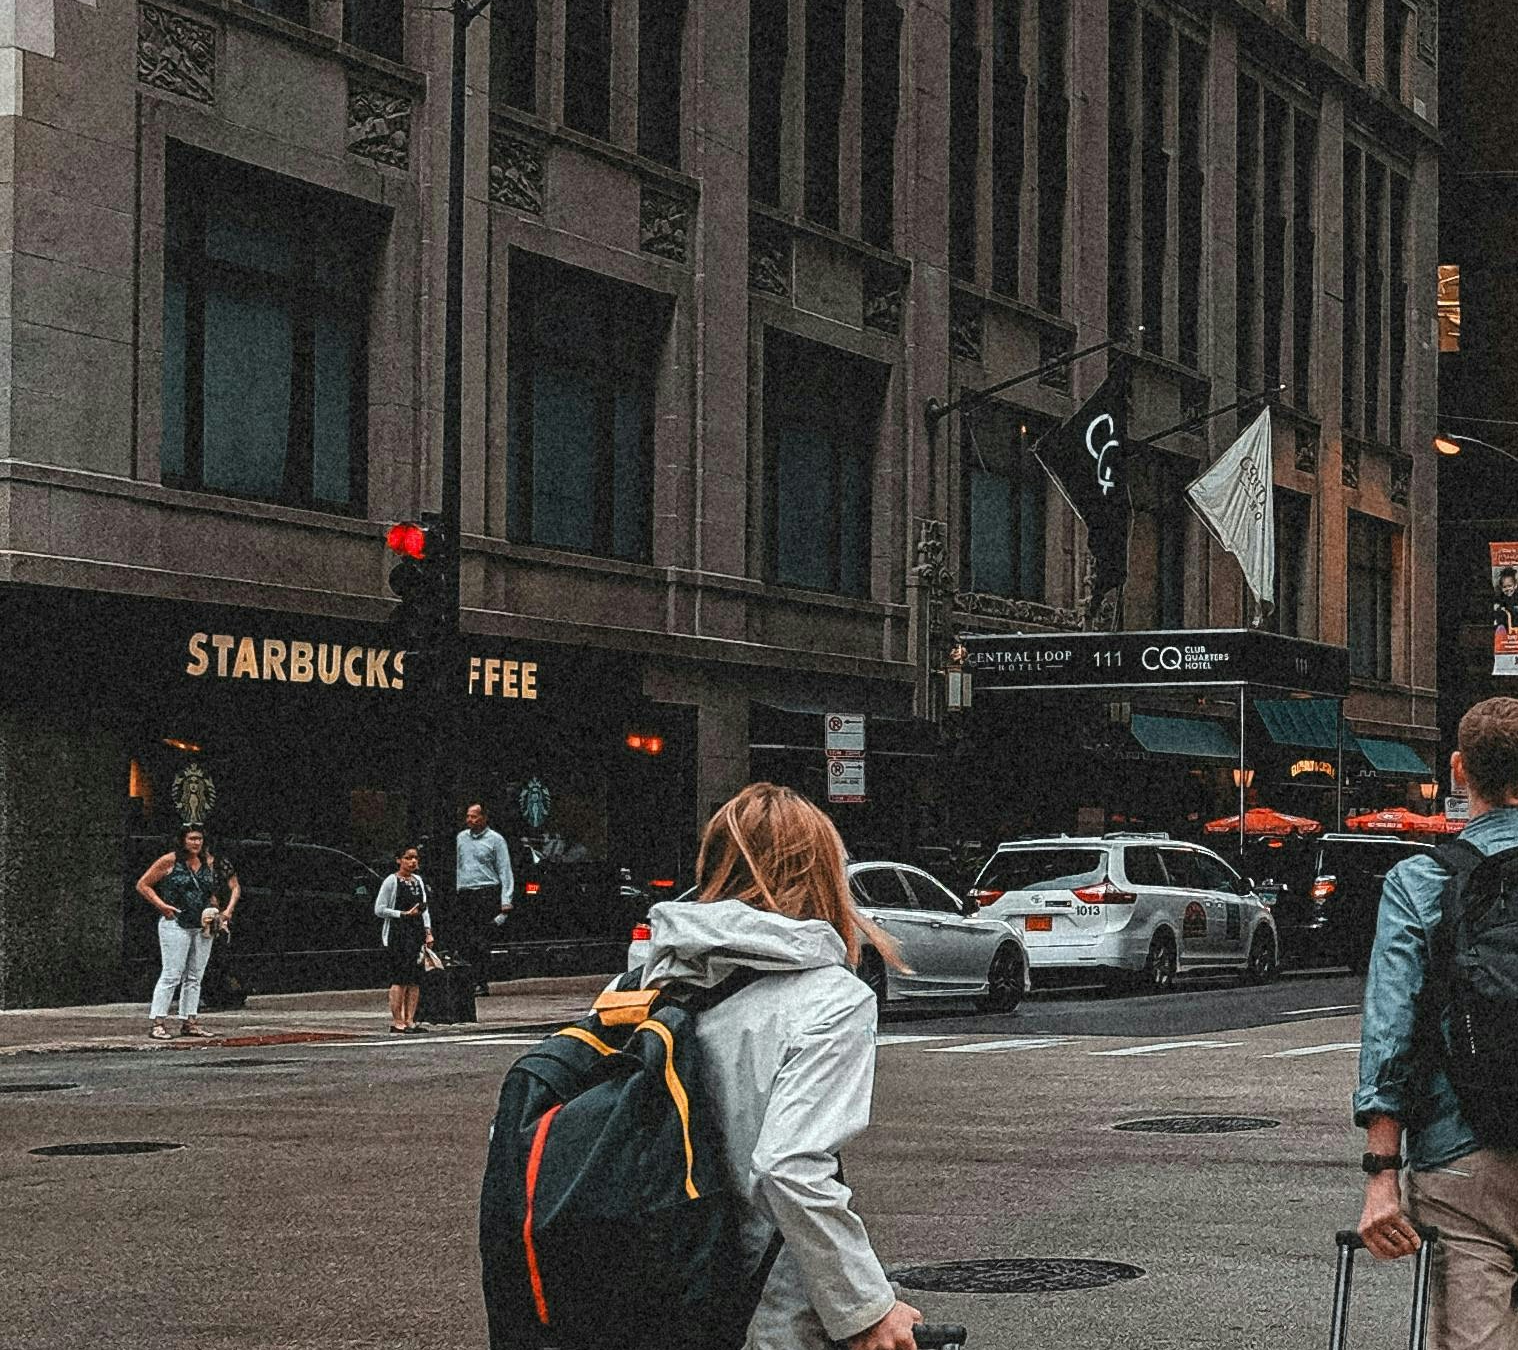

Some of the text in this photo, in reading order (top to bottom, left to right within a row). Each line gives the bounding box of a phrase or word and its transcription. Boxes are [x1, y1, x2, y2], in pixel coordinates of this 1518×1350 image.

[1184, 646, 1206, 654] CLUB
[967, 650, 1072, 664] CENTRAL LOOP
[1093, 651, 1122, 667] 111
[1142, 646, 1182, 670] CQ
[1184, 653, 1230, 662] QUARTERS
[997, 663, 1042, 672] HOTEL
[1184, 661, 1212, 670] HOTEL
[469, 657, 538, 699] FFEE
[1075, 905, 1101, 916] 1013
